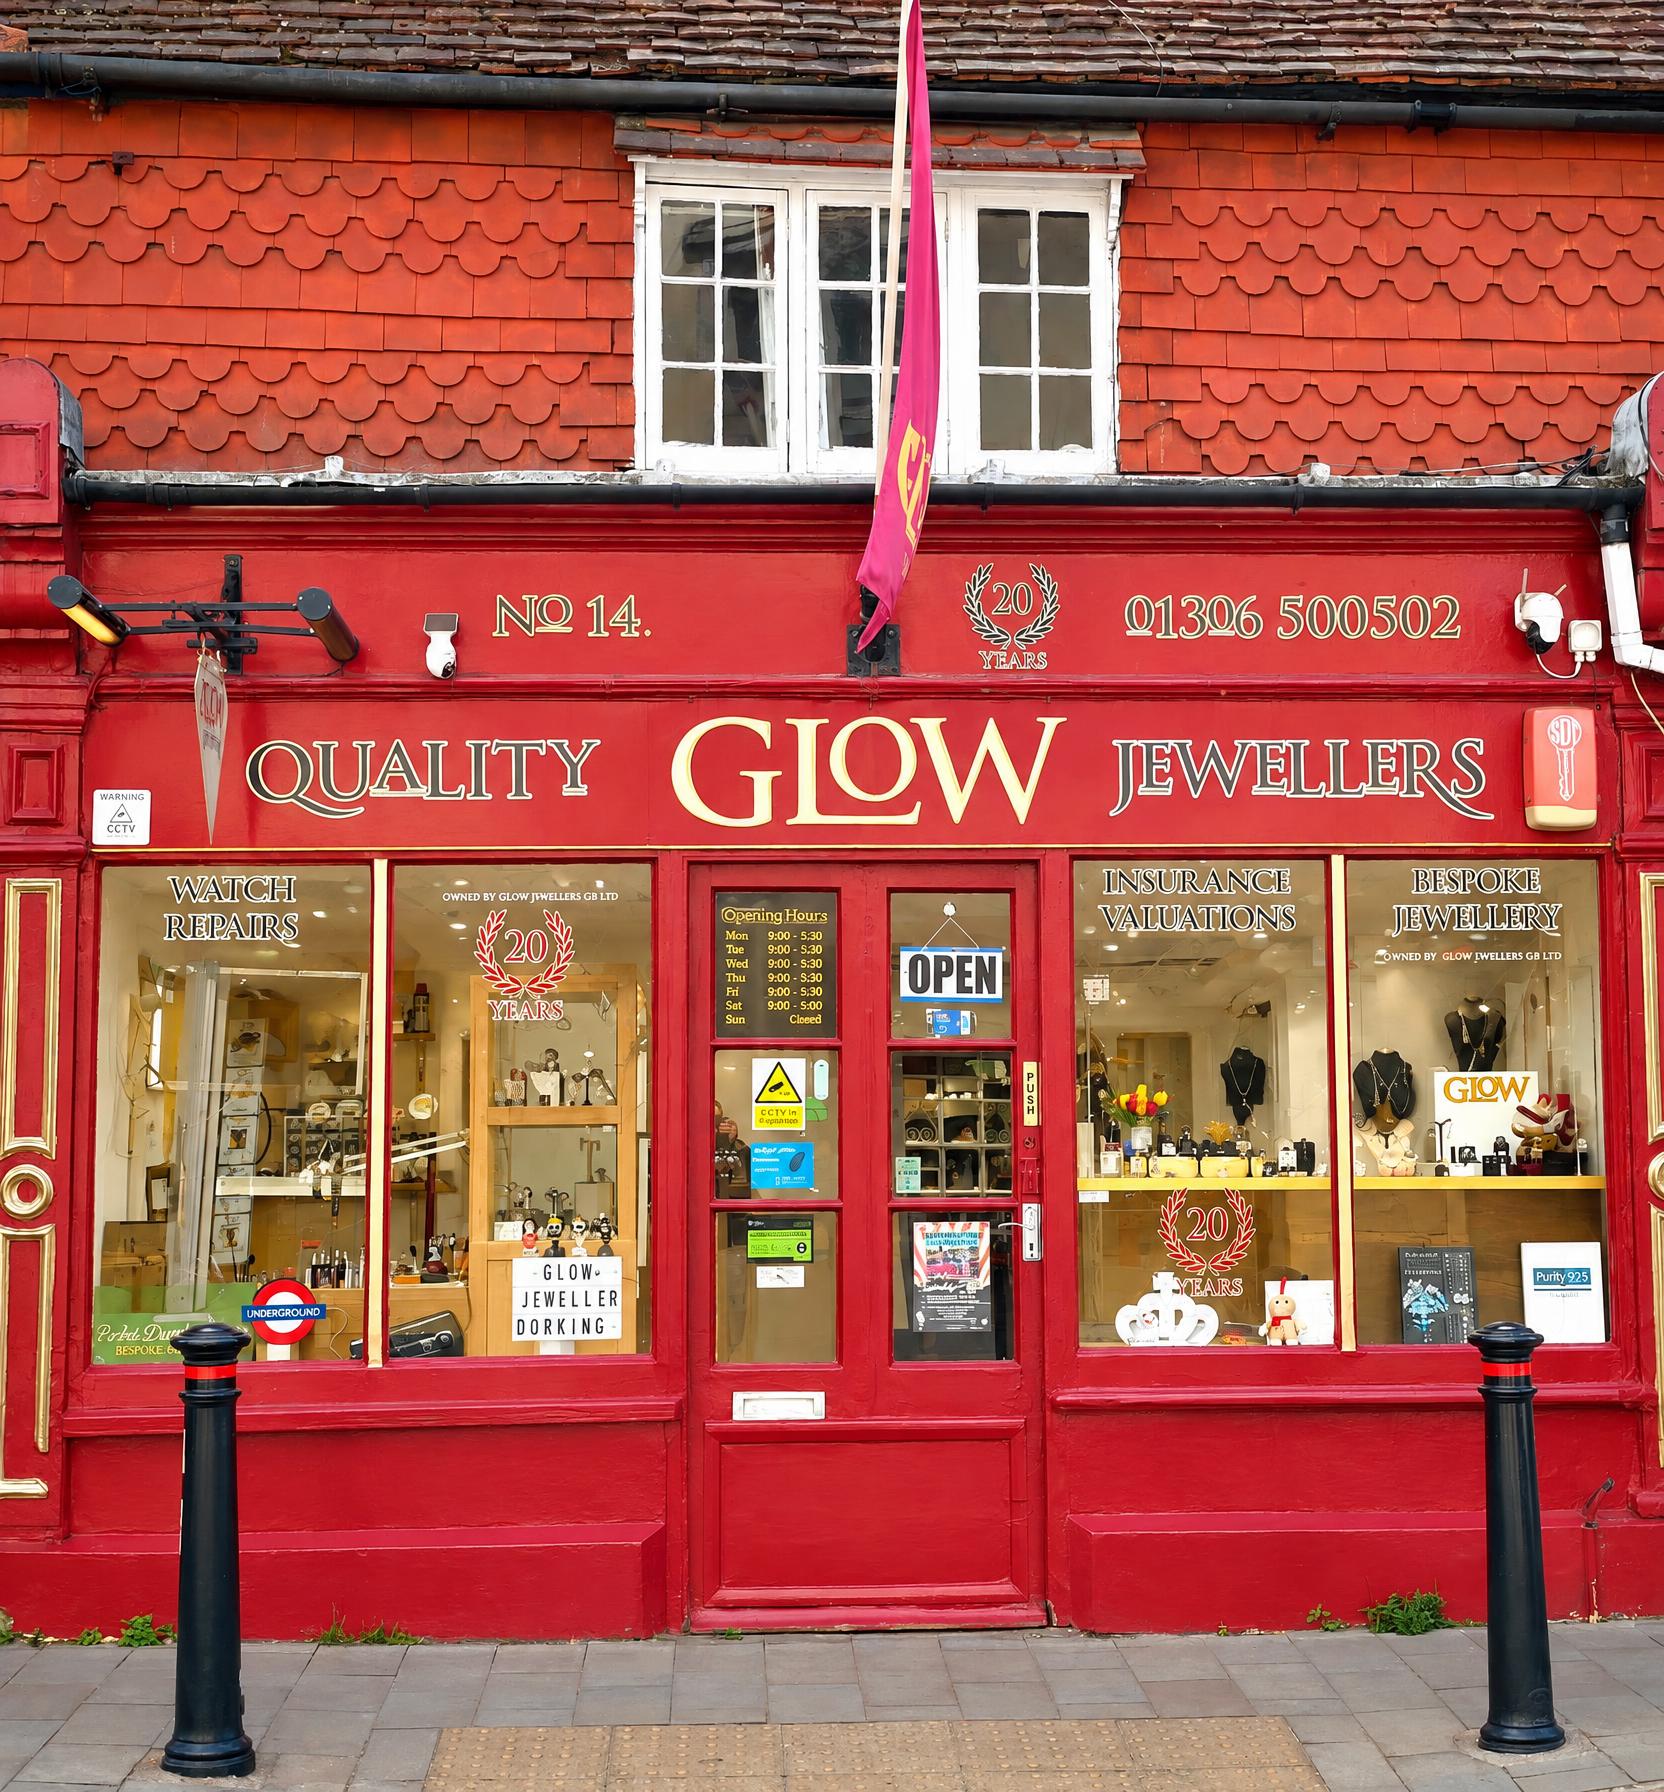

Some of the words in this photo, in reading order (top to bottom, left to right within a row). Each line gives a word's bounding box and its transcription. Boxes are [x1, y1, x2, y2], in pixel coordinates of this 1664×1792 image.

[992, 582, 1032, 615] 20
[587, 594, 651, 638] 14.
[1125, 594, 1264, 639] 01306
[1277, 594, 1461, 639] 500502
[978, 650, 1048, 670] YEARS
[246, 739, 601, 818] QUALITY
[671, 716, 1067, 827] GLOW
[1108, 738, 1495, 820] JEWELLERS
[99, 793, 145, 801] WARNING
[107, 824, 136, 833] CCTV
[167, 875, 296, 904] WATCH
[1103, 867, 1291, 895] INSURANCE
[1411, 867, 1541, 895] BESPOKE
[442, 892, 480, 901] OWNED
[483, 892, 497, 901] BY
[499, 892, 532, 901] GLOW
[583, 892, 598, 901] GB
[600, 892, 619, 901] LTD
[722, 907, 782, 924] Opening
[784, 908, 828, 923] Hours
[1098, 904, 1296, 932] VALUATIONS
[1392, 903, 1563, 938] JEWELLERY
[164, 912, 301, 948] REPAIRS
[725, 931, 748, 941] Mon
[768, 931, 790, 941] 9:00
[503, 928, 549, 963] 20
[725, 945, 744, 955] Tue
[768, 945, 790, 955] 9:00
[725, 959, 749, 969] Wed
[768, 959, 790, 969] 9:00
[1383, 952, 1421, 961] OWNED
[1424, 952, 1437, 960] BY
[1442, 952, 1472, 961] GLOW
[1525, 952, 1540, 960] GB
[1543, 952, 1562, 960] LTD
[725, 973, 746, 983] Thu
[768, 973, 790, 983] 9:00
[908, 953, 997, 994] OPEN
[725, 987, 739, 997] Fri
[768, 987, 790, 997] 9:00
[487, 1000, 563, 1021] YEARS
[725, 1001, 742, 1011] Sat
[768, 1001, 790, 1011] 9:00
[725, 1015, 746, 1024] Sun
[1026, 1072, 1035, 1115] PUSH
[1443, 1075, 1531, 1103] GLOW
[1186, 1206, 1229, 1241] 20
[543, 1263, 593, 1280] GLOW
[1536, 1271, 1566, 1284] Purity
[1567, 1271, 1589, 1283] 925
[1176, 1277, 1243, 1297] YEARS
[522, 1290, 618, 1308] JEWELLER
[246, 1307, 321, 1318] UNDERGROUND
[517, 1317, 604, 1335] DORKING
